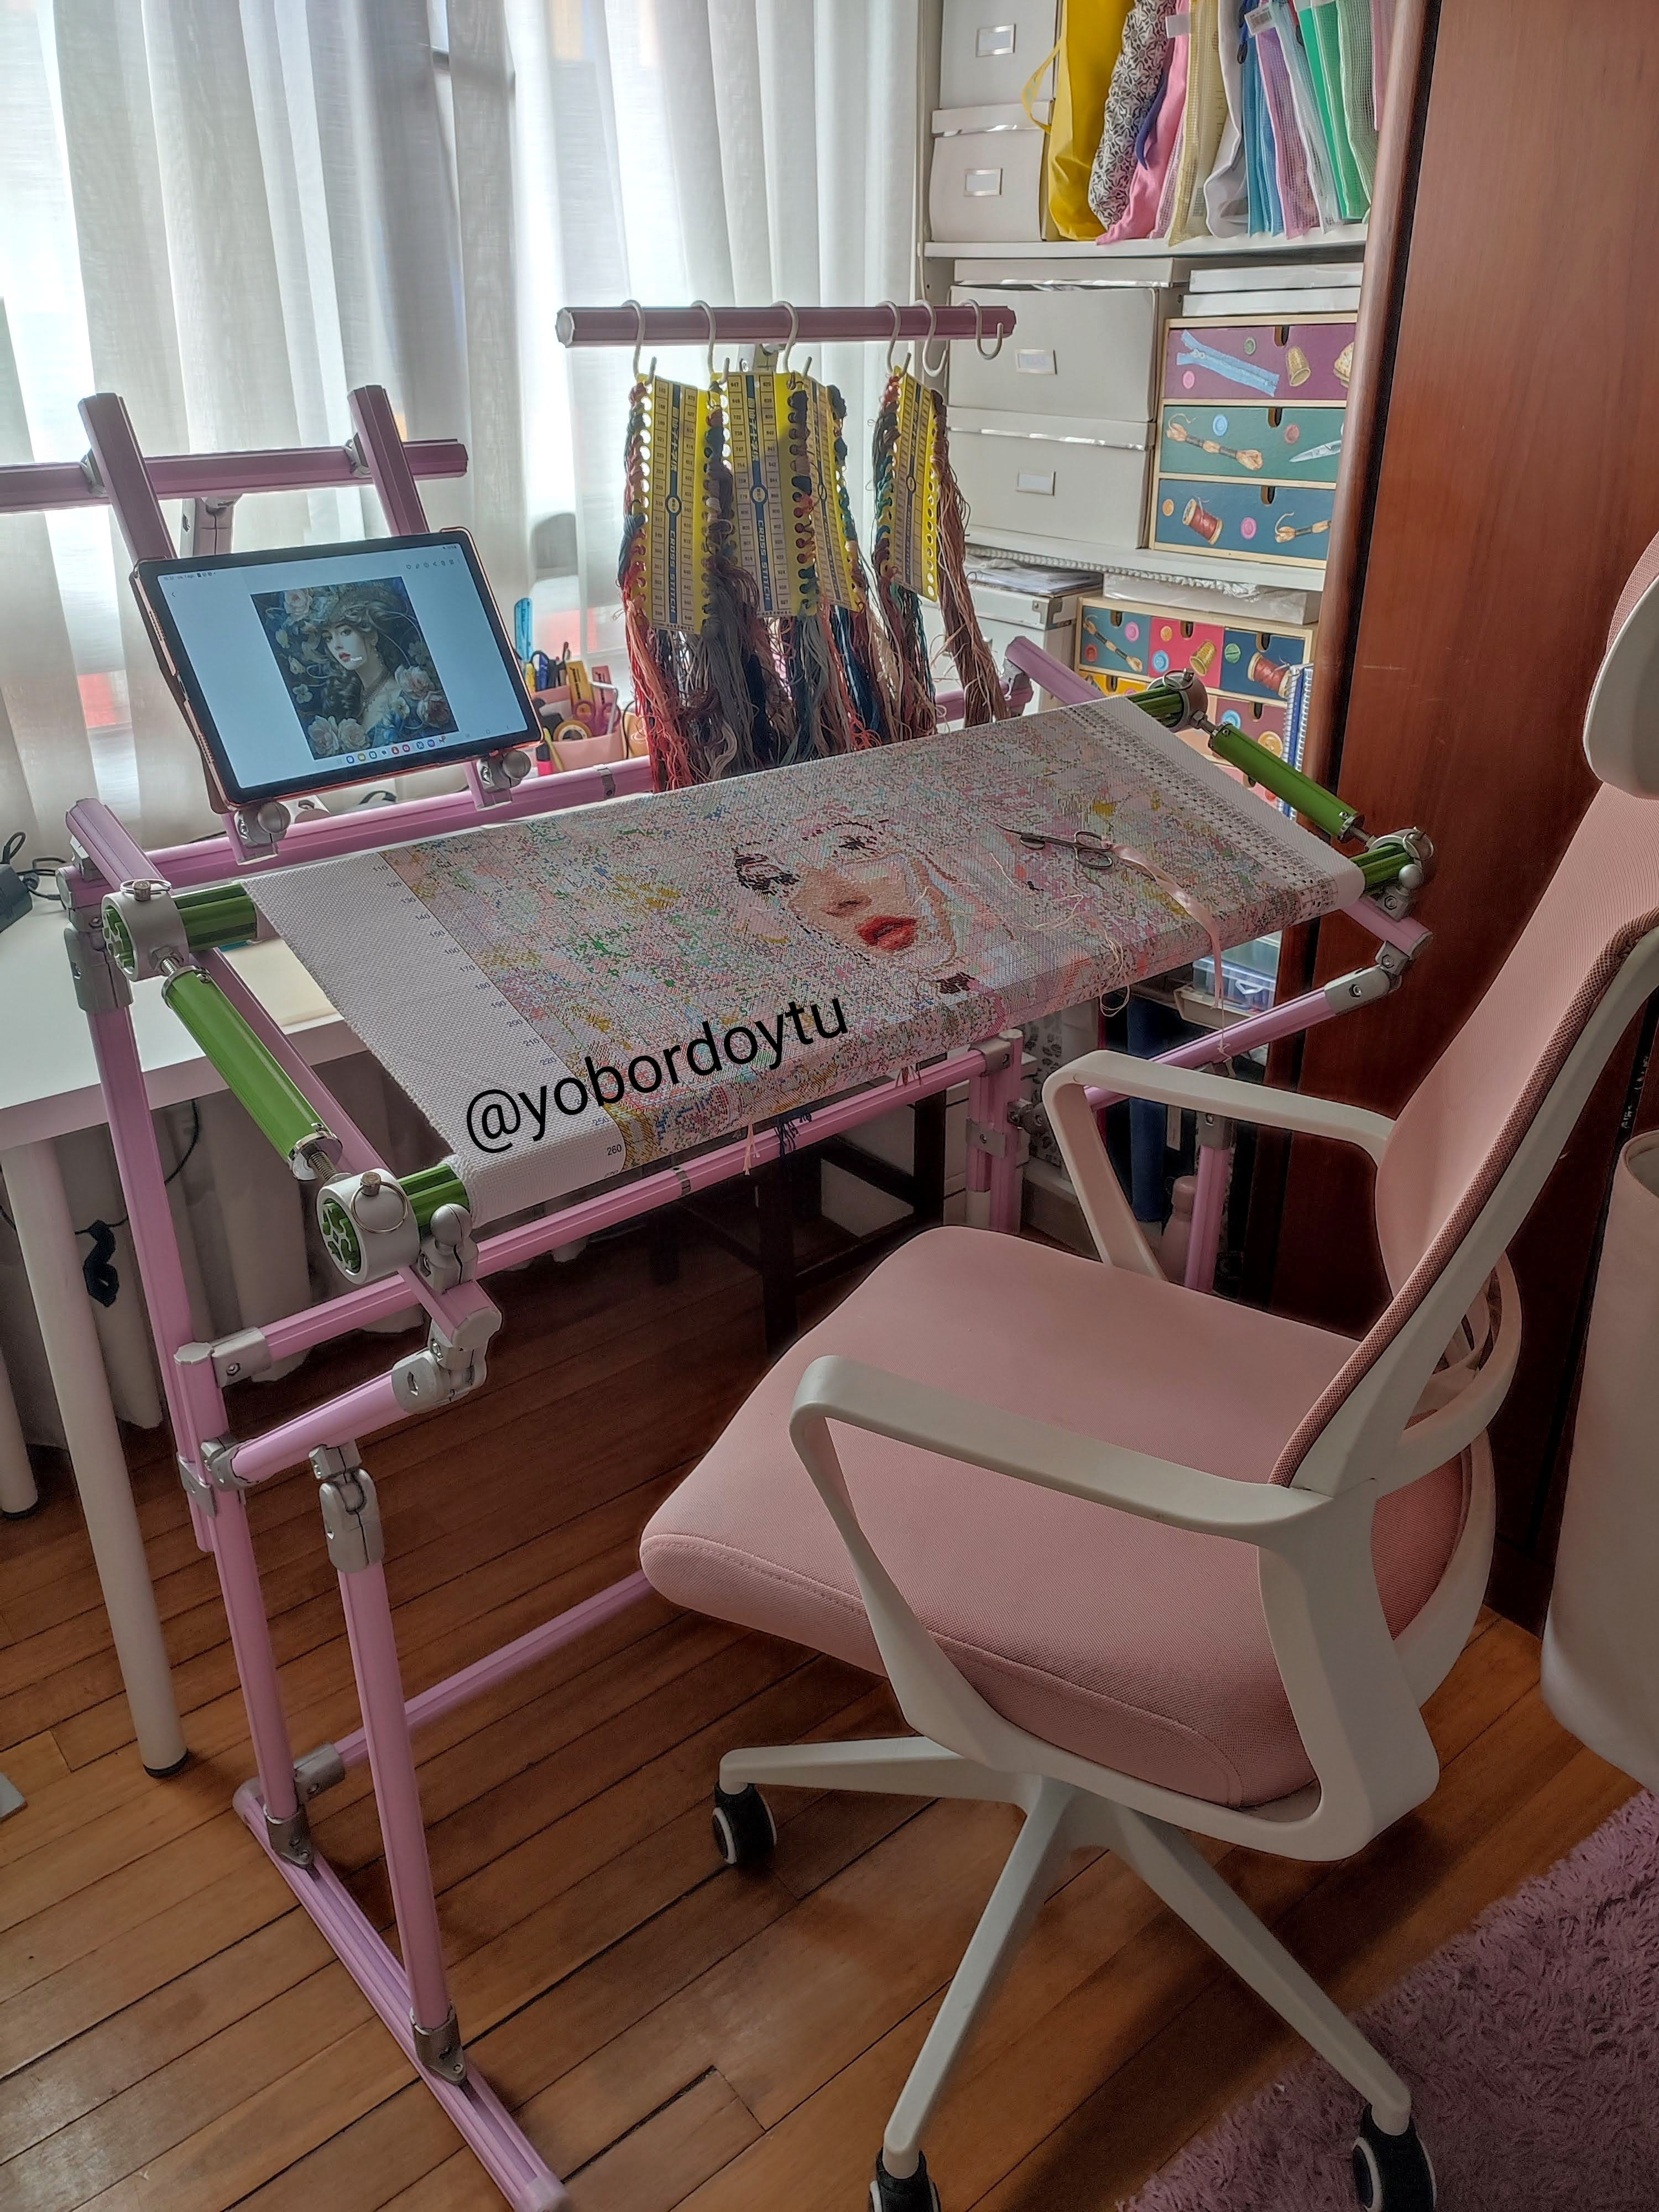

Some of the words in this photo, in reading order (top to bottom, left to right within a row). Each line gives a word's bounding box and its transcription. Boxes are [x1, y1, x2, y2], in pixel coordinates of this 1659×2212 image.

[762, 562, 770, 600] STITCH
[523, 1038, 540, 1046] 210
[539, 1057, 557, 1066] 220
[592, 1116, 609, 1126] 250
[607, 1144, 622, 1156] 260
